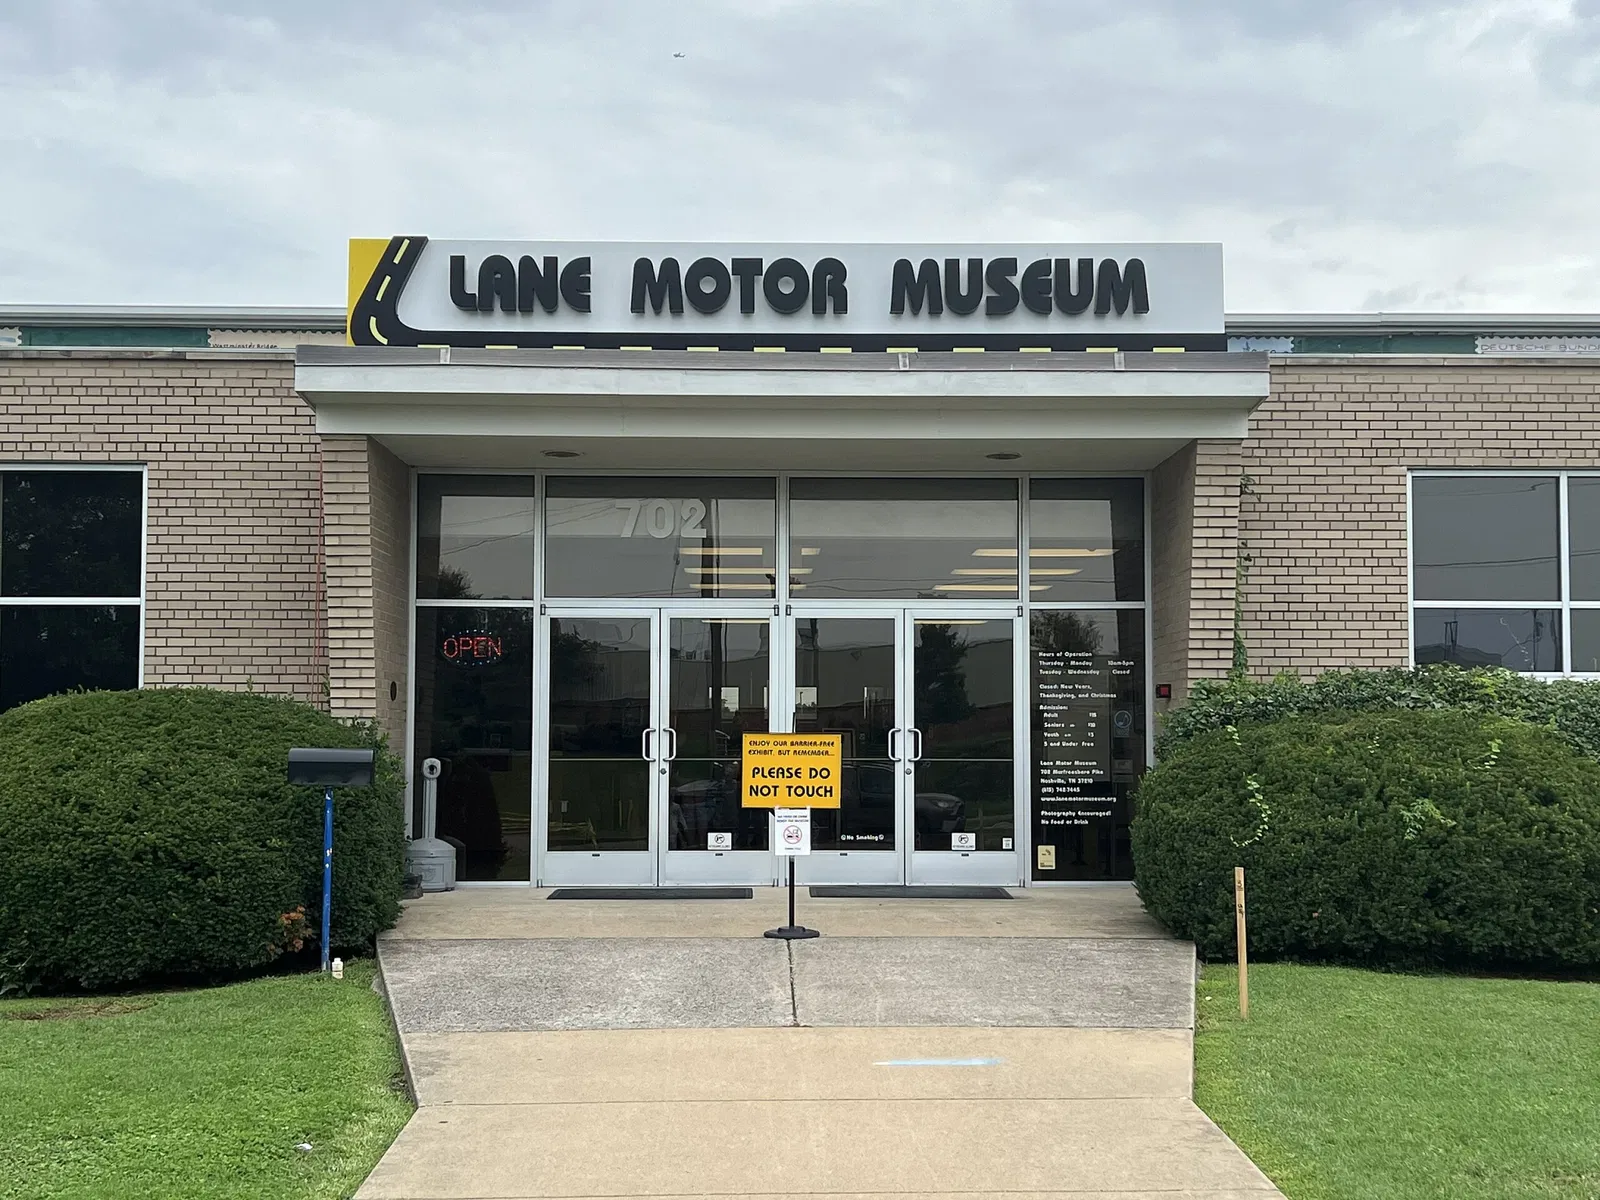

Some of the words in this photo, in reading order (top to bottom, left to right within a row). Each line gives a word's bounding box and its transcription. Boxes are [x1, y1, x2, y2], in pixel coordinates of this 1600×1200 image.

[449, 254, 592, 313] LANE
[630, 256, 848, 315] MOTOR
[889, 257, 1150, 316] MUSEUM
[1480, 343, 1552, 351] DEUTSCHE
[615, 499, 707, 538] 702
[443, 637, 503, 658] OPEN
[1064, 651, 1093, 659] Operation
[1039, 692, 1077, 700] Thanksgiving,
[789, 740, 835, 748] BARRIER-FREE
[751, 766, 802, 779] PLEASE
[808, 767, 831, 779] DO
[749, 784, 780, 797] NOT
[785, 785, 833, 798] TOUCH
[1041, 810, 1076, 818] Photography
[856, 834, 879, 842] Smoking
